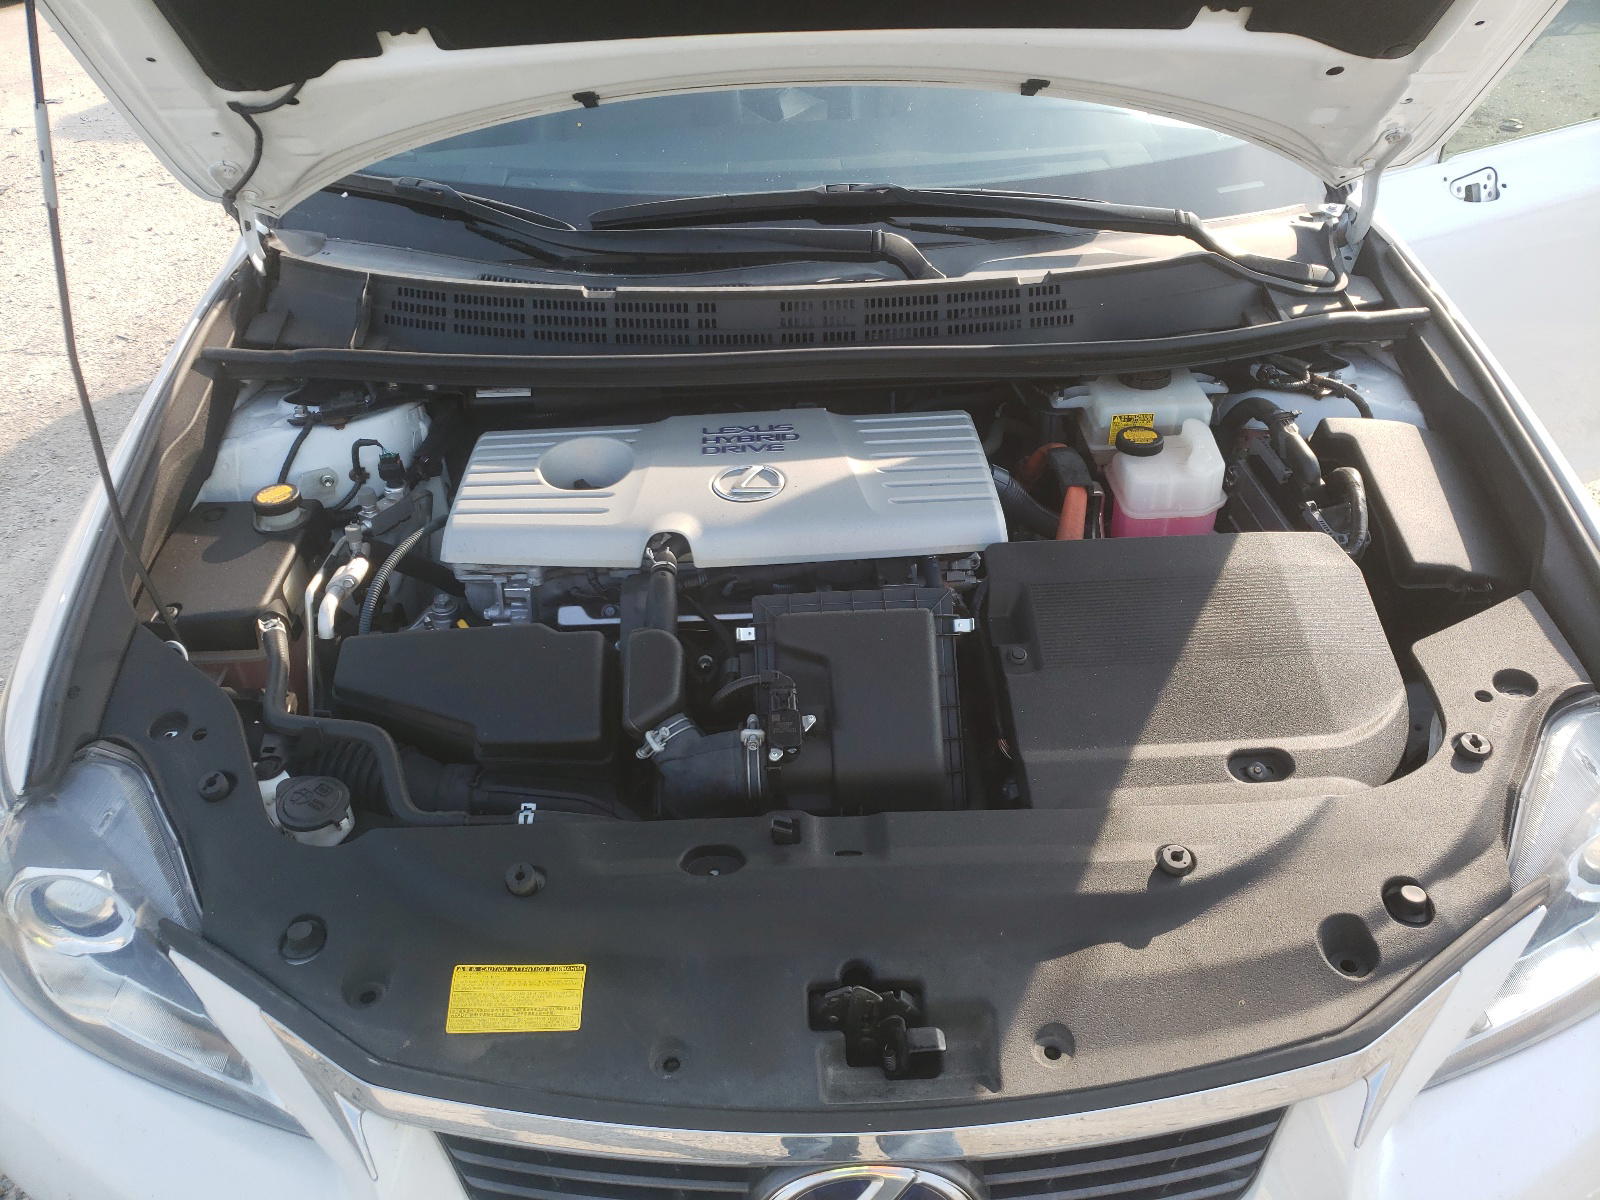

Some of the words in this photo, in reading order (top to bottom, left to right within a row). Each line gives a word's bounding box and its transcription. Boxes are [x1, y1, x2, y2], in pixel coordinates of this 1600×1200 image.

[702, 424, 794, 435] LEXUS
[702, 433, 800, 445] HYBRID
[702, 443, 785, 455] DRIVE
